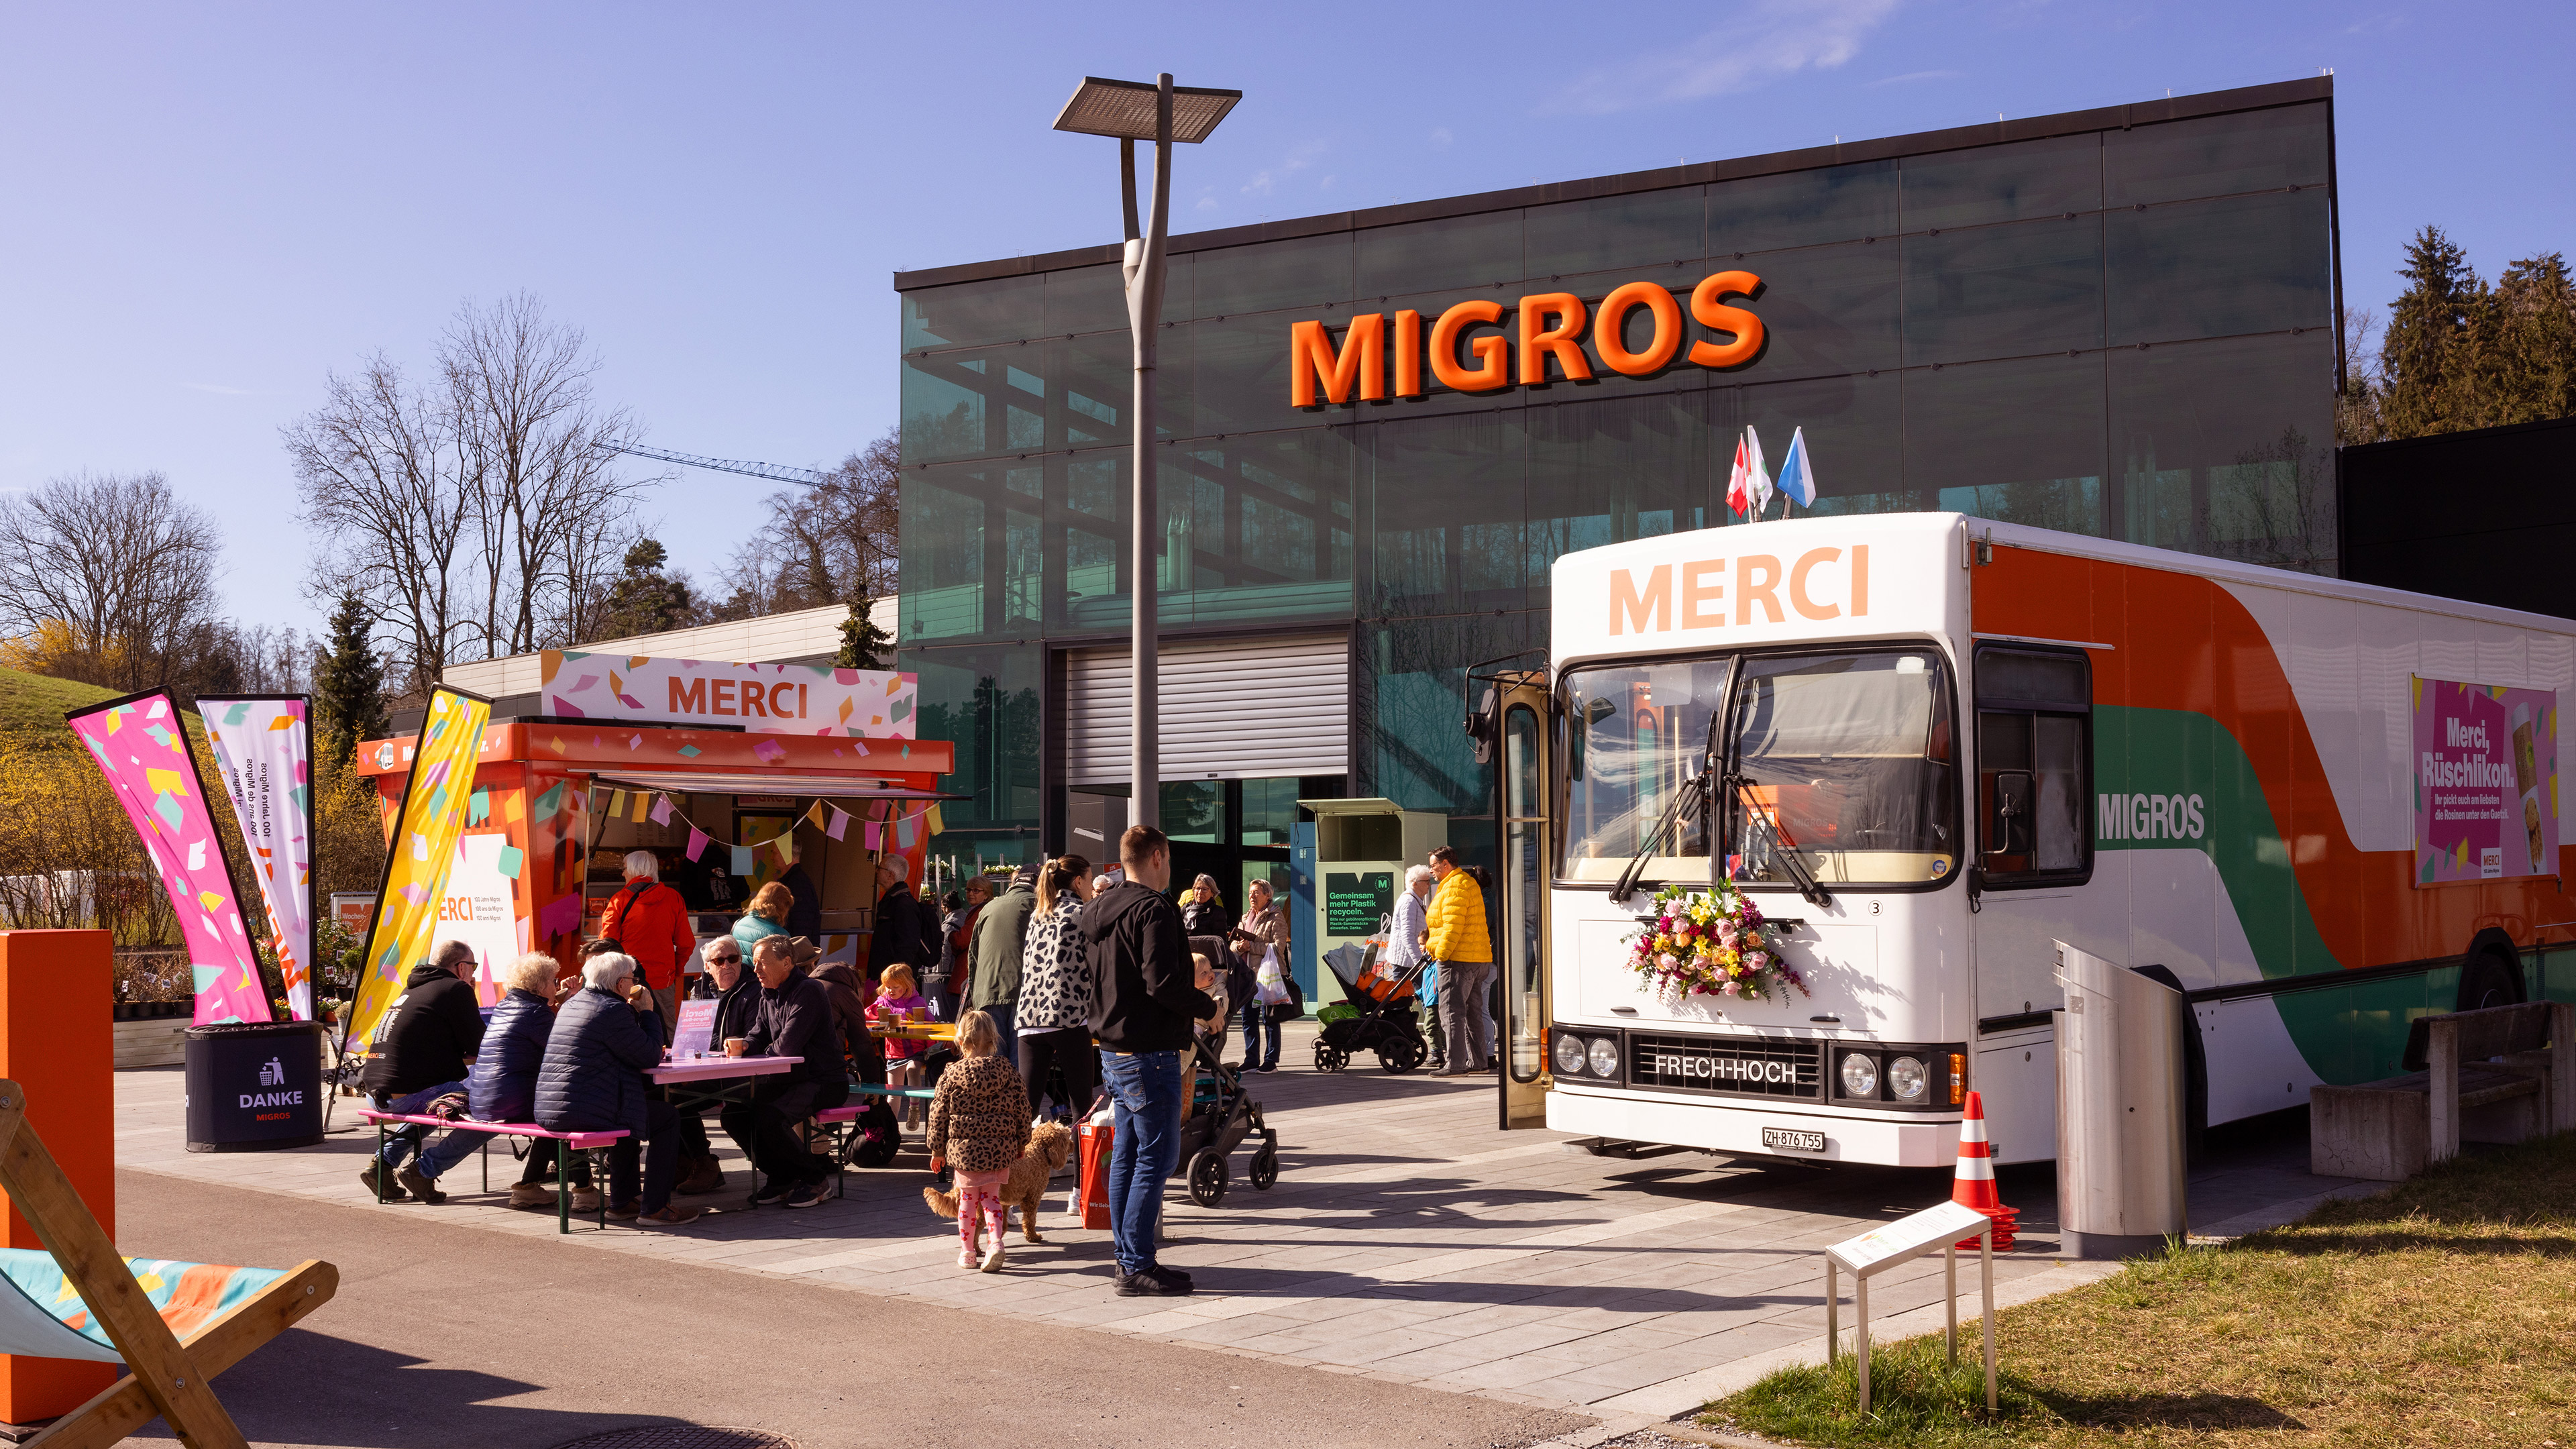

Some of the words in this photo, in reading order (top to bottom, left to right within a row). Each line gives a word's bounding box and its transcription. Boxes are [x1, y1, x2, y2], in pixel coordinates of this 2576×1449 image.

[1291, 270, 1765, 407] MIGROS
[1609, 544, 1869, 636] MERCI
[668, 676, 807, 718] MERCI
[2447, 717, 2490, 755] Merci,
[2422, 751, 2514, 788] Rüschlikon.
[2434, 794, 2443, 805] Ihr
[2443, 794, 2457, 807] pickt
[2457, 794, 2471, 805] euch
[2471, 796, 2479, 805] am
[2479, 794, 2500, 805] liebsten
[2098, 793, 2204, 840] MIGROS
[2435, 809, 2444, 820] die
[2444, 809, 2465, 820] Rosinen
[2465, 810, 2480, 820] unter
[2480, 809, 2490, 820] den
[2483, 855, 2500, 866] MERCI
[1378, 879, 1387, 888] M
[1329, 892, 1375, 900] Gemeinsam
[437, 897, 474, 921] ERCI
[1350, 900, 1377, 908] Plastik
[1872, 902, 1880, 914] 3
[1330, 908, 1364, 916] recyceln.
[1655, 1055, 1796, 1083] FRECH-HOCH
[239, 1090, 303, 1108] DANKE
[256, 1112, 290, 1122] MIGROS
